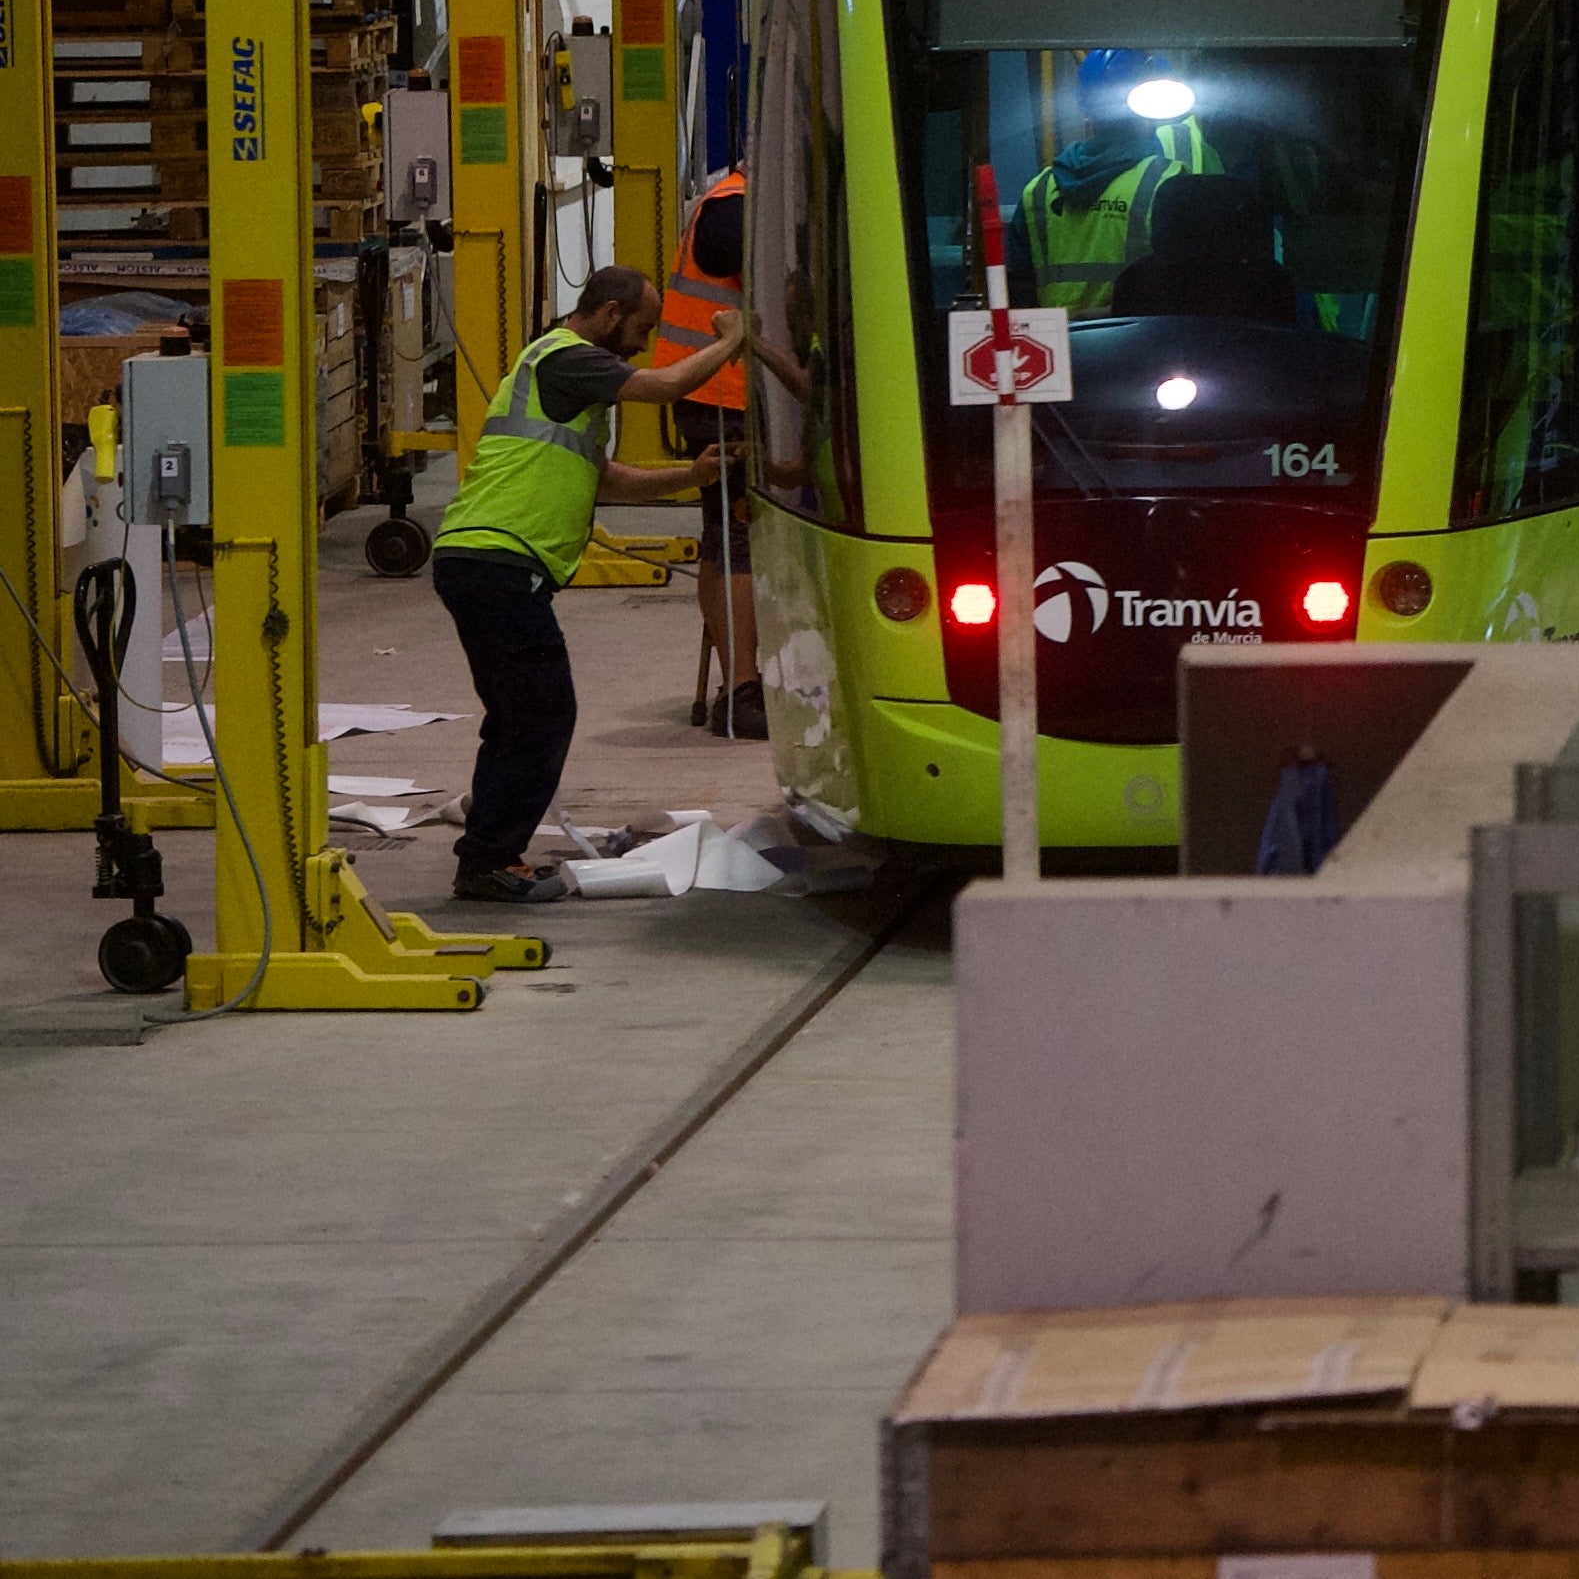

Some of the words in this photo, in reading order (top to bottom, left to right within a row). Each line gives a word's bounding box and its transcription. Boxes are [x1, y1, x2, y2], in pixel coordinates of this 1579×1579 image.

[233, 37, 257, 134] SEFAC
[165, 461, 174, 470] 2
[1263, 443, 1338, 478] 164
[1115, 589, 1262, 629] Tranvía
[1191, 630, 1210, 645] de
[1213, 631, 1263, 646] Murcia
